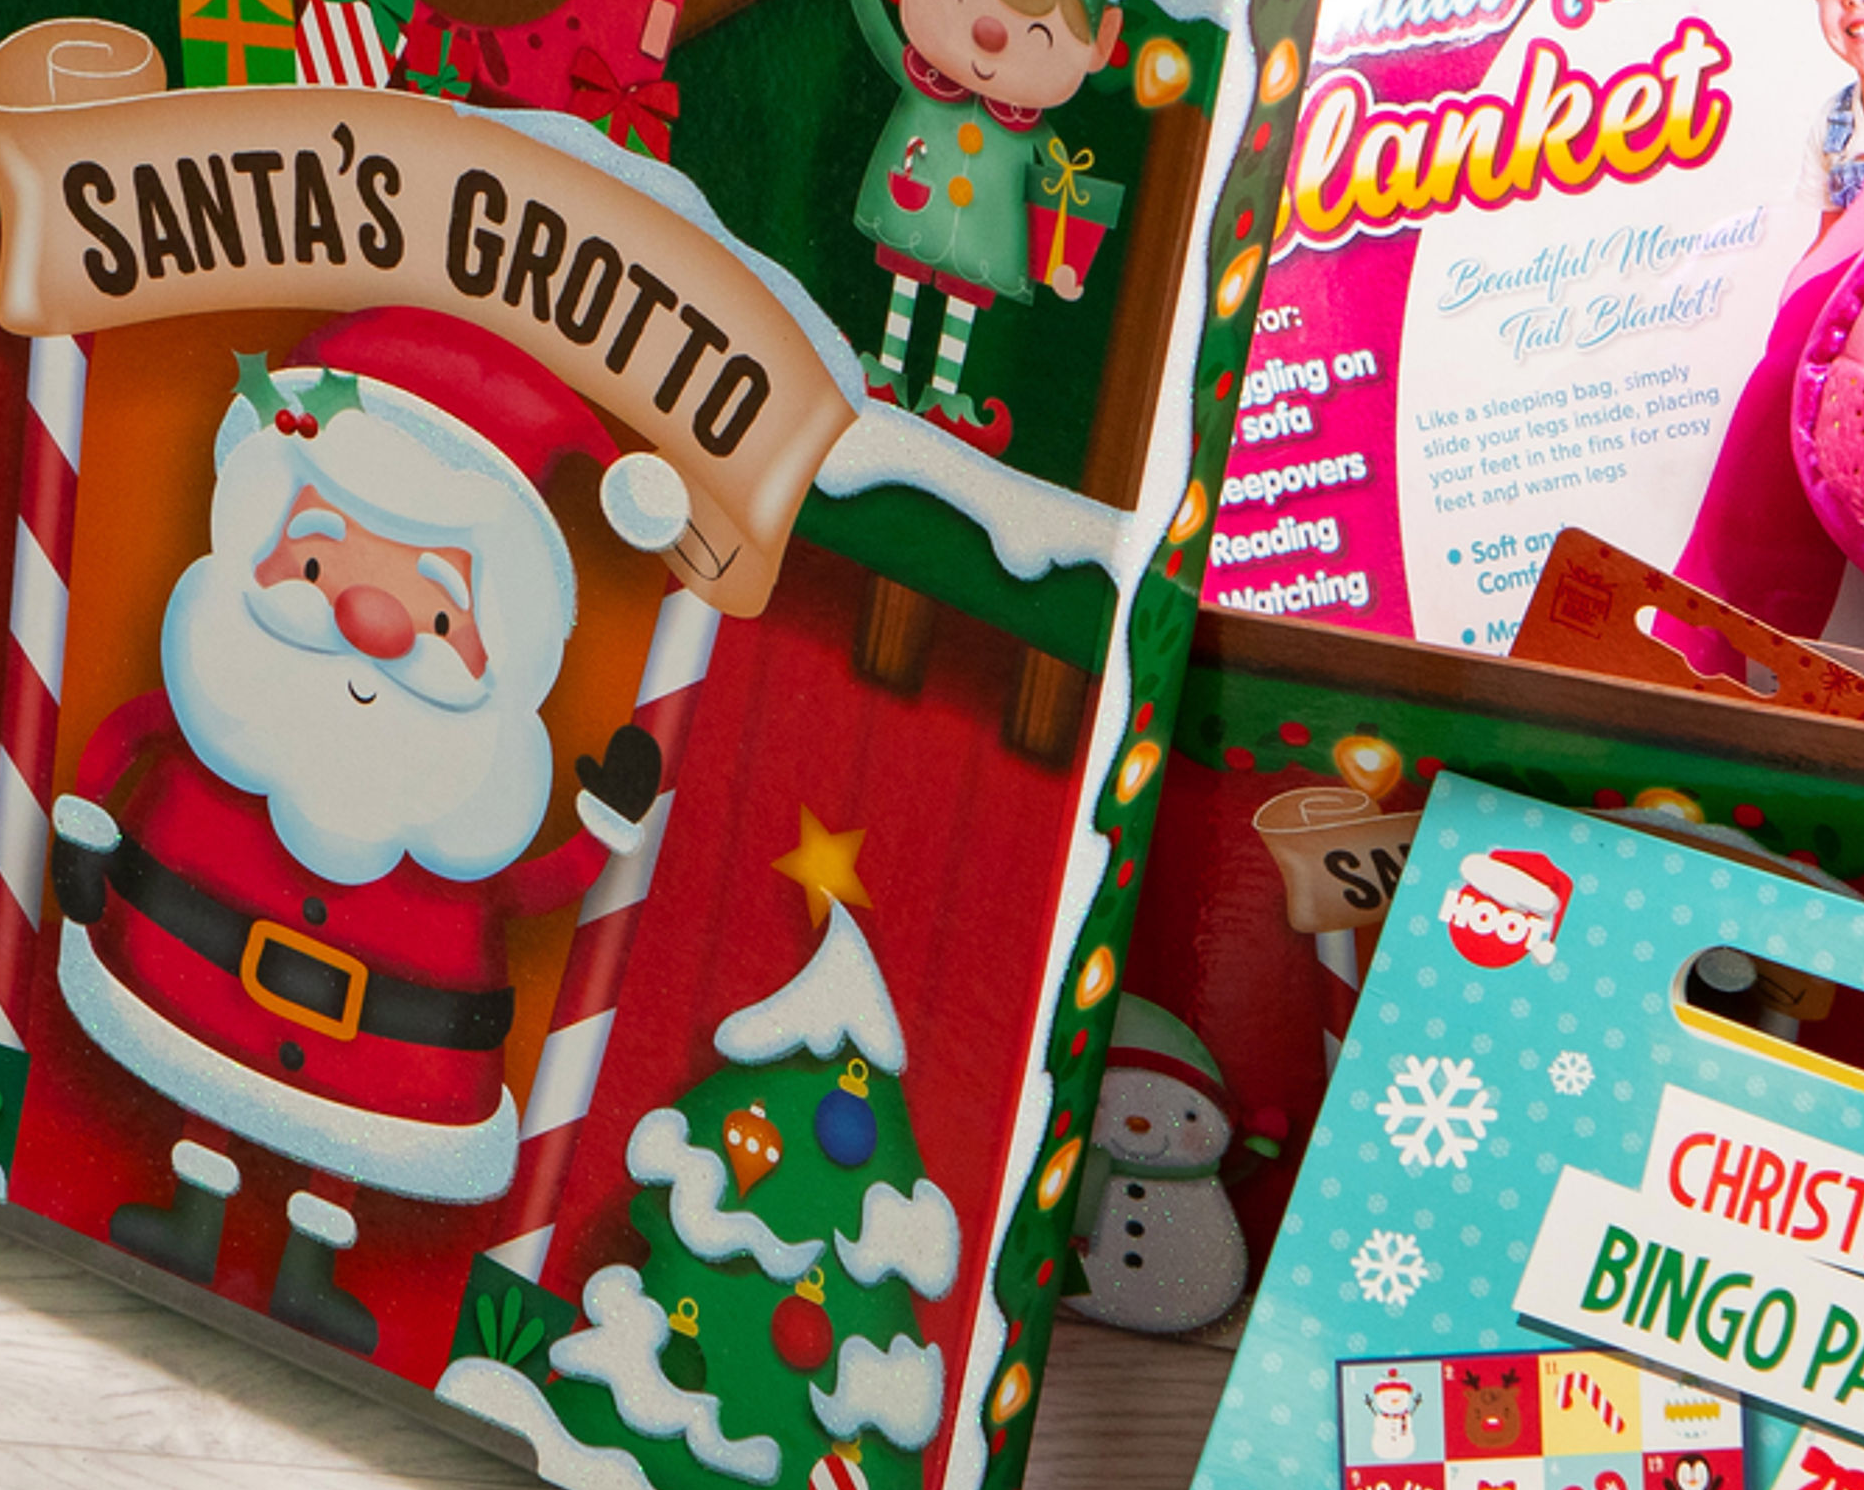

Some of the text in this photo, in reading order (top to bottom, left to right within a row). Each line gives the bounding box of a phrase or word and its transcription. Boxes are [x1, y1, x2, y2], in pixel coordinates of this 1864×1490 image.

[1274, 26, 1725, 238] lanket
[61, 120, 773, 460] SANTA'S GROTTO
[1437, 205, 1764, 312] Beautiful Mermaid
[1498, 276, 1723, 360] Tail Blanket!
[1332, 349, 1378, 380] on
[1415, 363, 1692, 432] Like a sleeping bag, simply
[1240, 401, 1313, 444] sofa
[1422, 386, 1722, 460] slide your legs inside, placing
[1428, 415, 1712, 491] your feet in the fins for cosy
[1433, 460, 1629, 515] feet and warm legs
[1209, 516, 1341, 568] Reading
[1469, 522, 1567, 565] Soft an
[1323, 843, 1413, 910] SA
[1438, 889, 1552, 952] HOOT
[1579, 1223, 1798, 1372] BINGO
